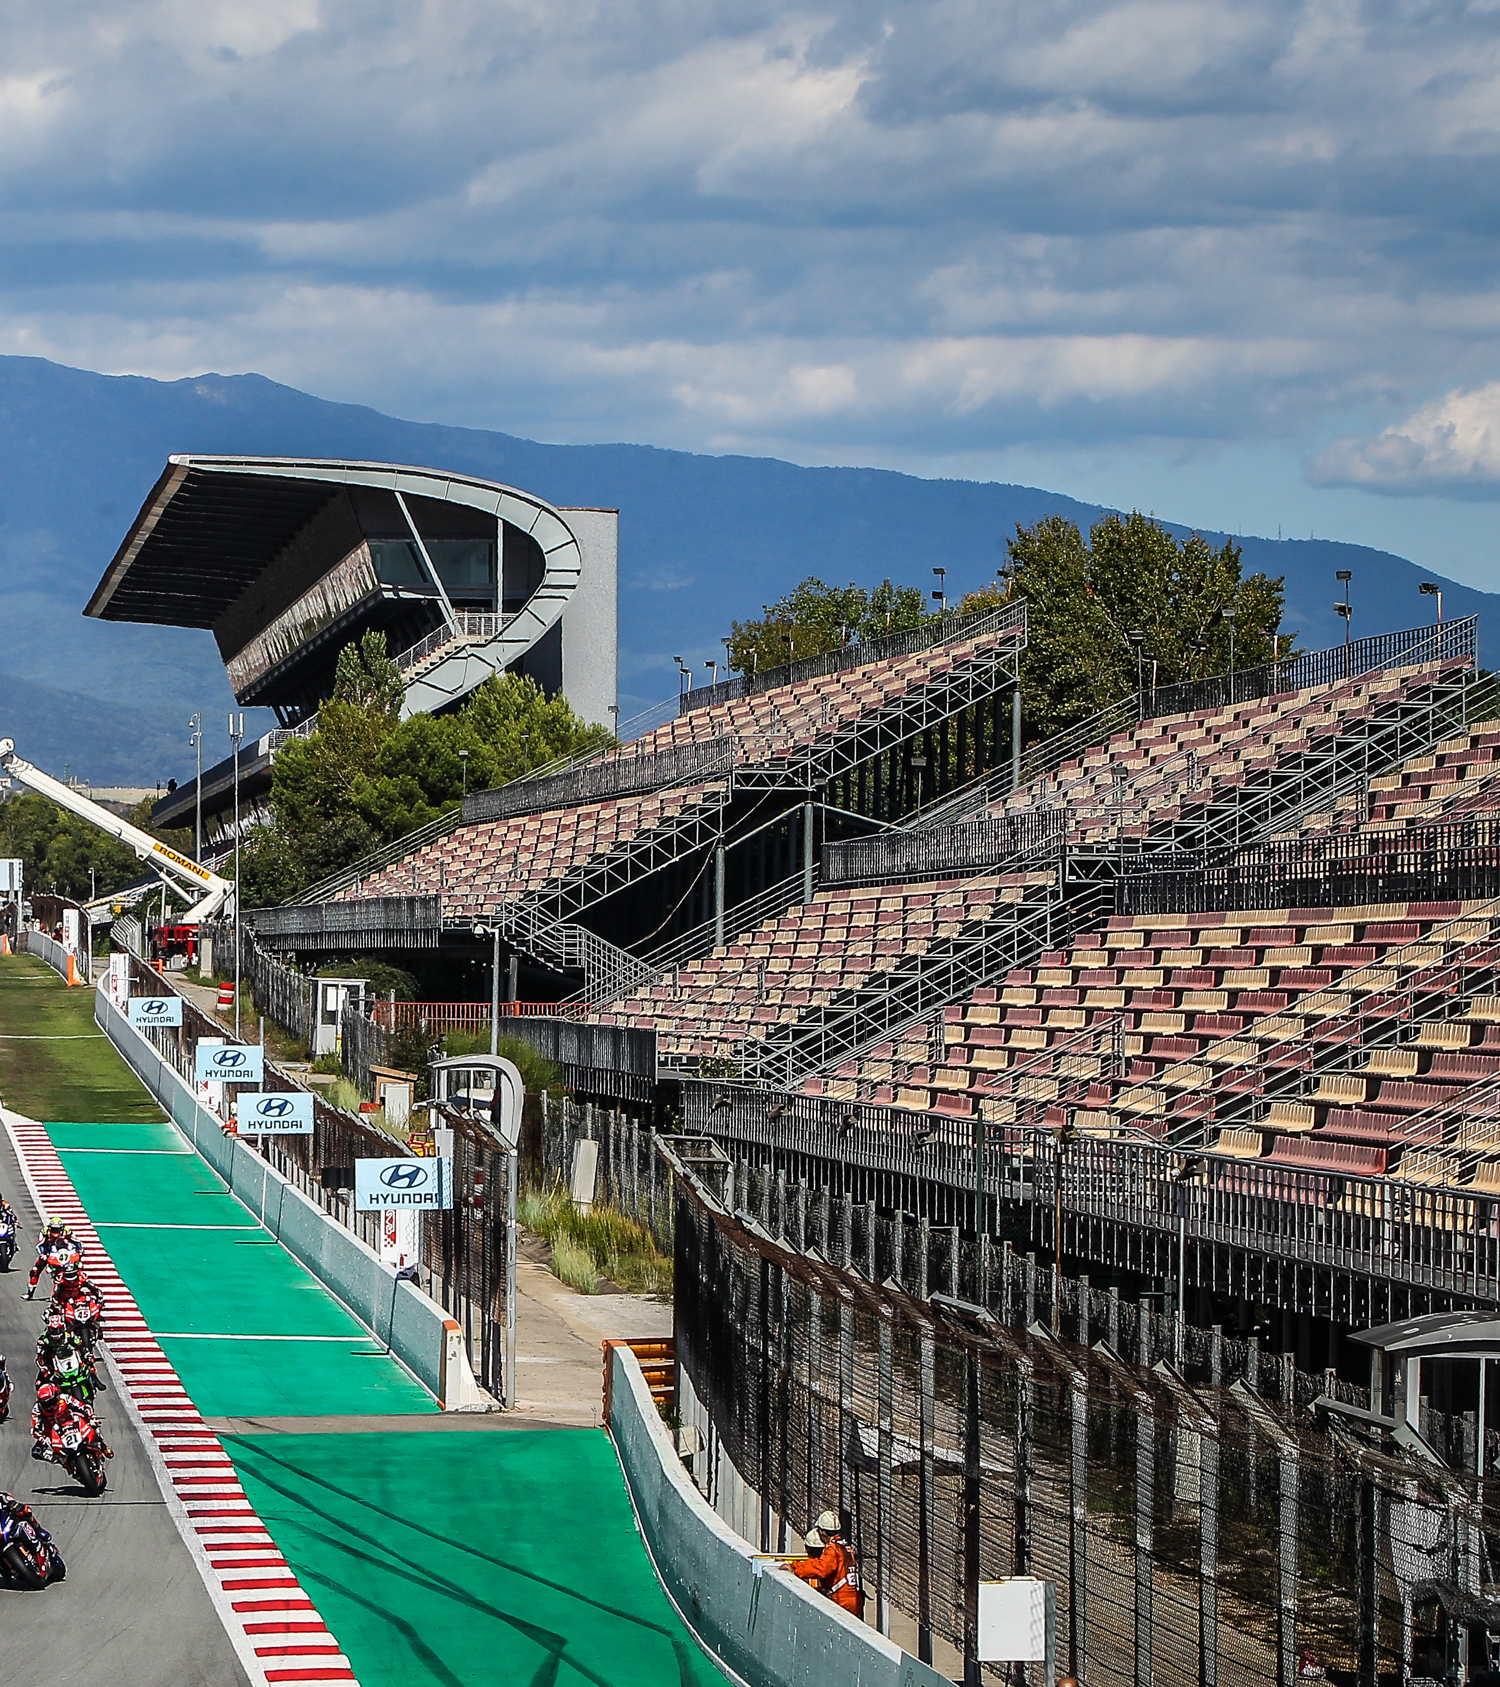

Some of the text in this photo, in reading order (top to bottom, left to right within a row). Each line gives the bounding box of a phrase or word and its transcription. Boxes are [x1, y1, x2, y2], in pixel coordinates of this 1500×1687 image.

[135, 1016, 175, 1024] HYUNDAI
[205, 1069, 254, 1079] HYUNDAI
[248, 1120, 303, 1130] HYUNDAI
[369, 1193, 439, 1205] HYUNDAI
[66, 1434, 79, 1447] 21
